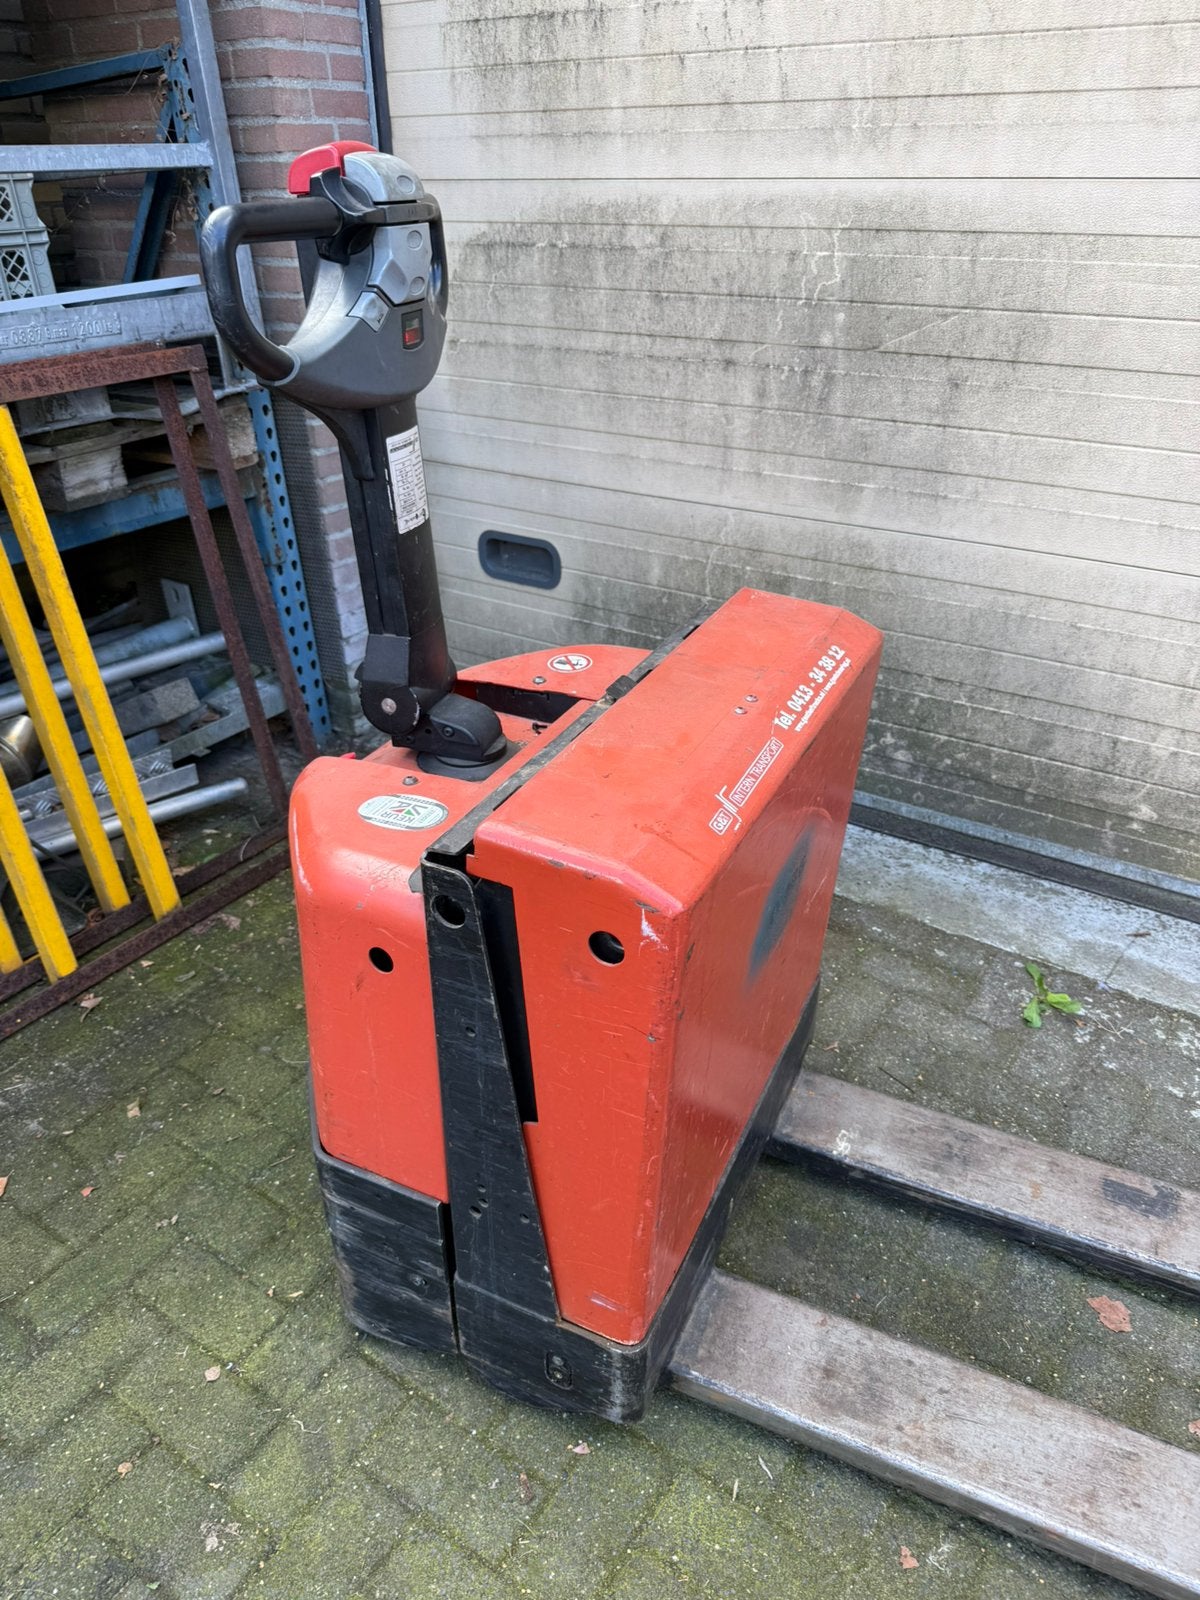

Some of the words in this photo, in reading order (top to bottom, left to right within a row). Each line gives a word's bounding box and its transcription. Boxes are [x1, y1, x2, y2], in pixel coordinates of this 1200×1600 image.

[71, 320, 102, 337] 1200
[827, 645, 845, 660] 12
[817, 655, 836, 671] 38
[808, 667, 827, 683] 34
[786, 684, 814, 712] 0413
[773, 710, 797, 730] Tel.
[732, 775, 757, 803] INTERN
[749, 740, 781, 778] TRANSPORT
[380, 811, 416, 824] KEUR
[712, 811, 731, 831] G&T
